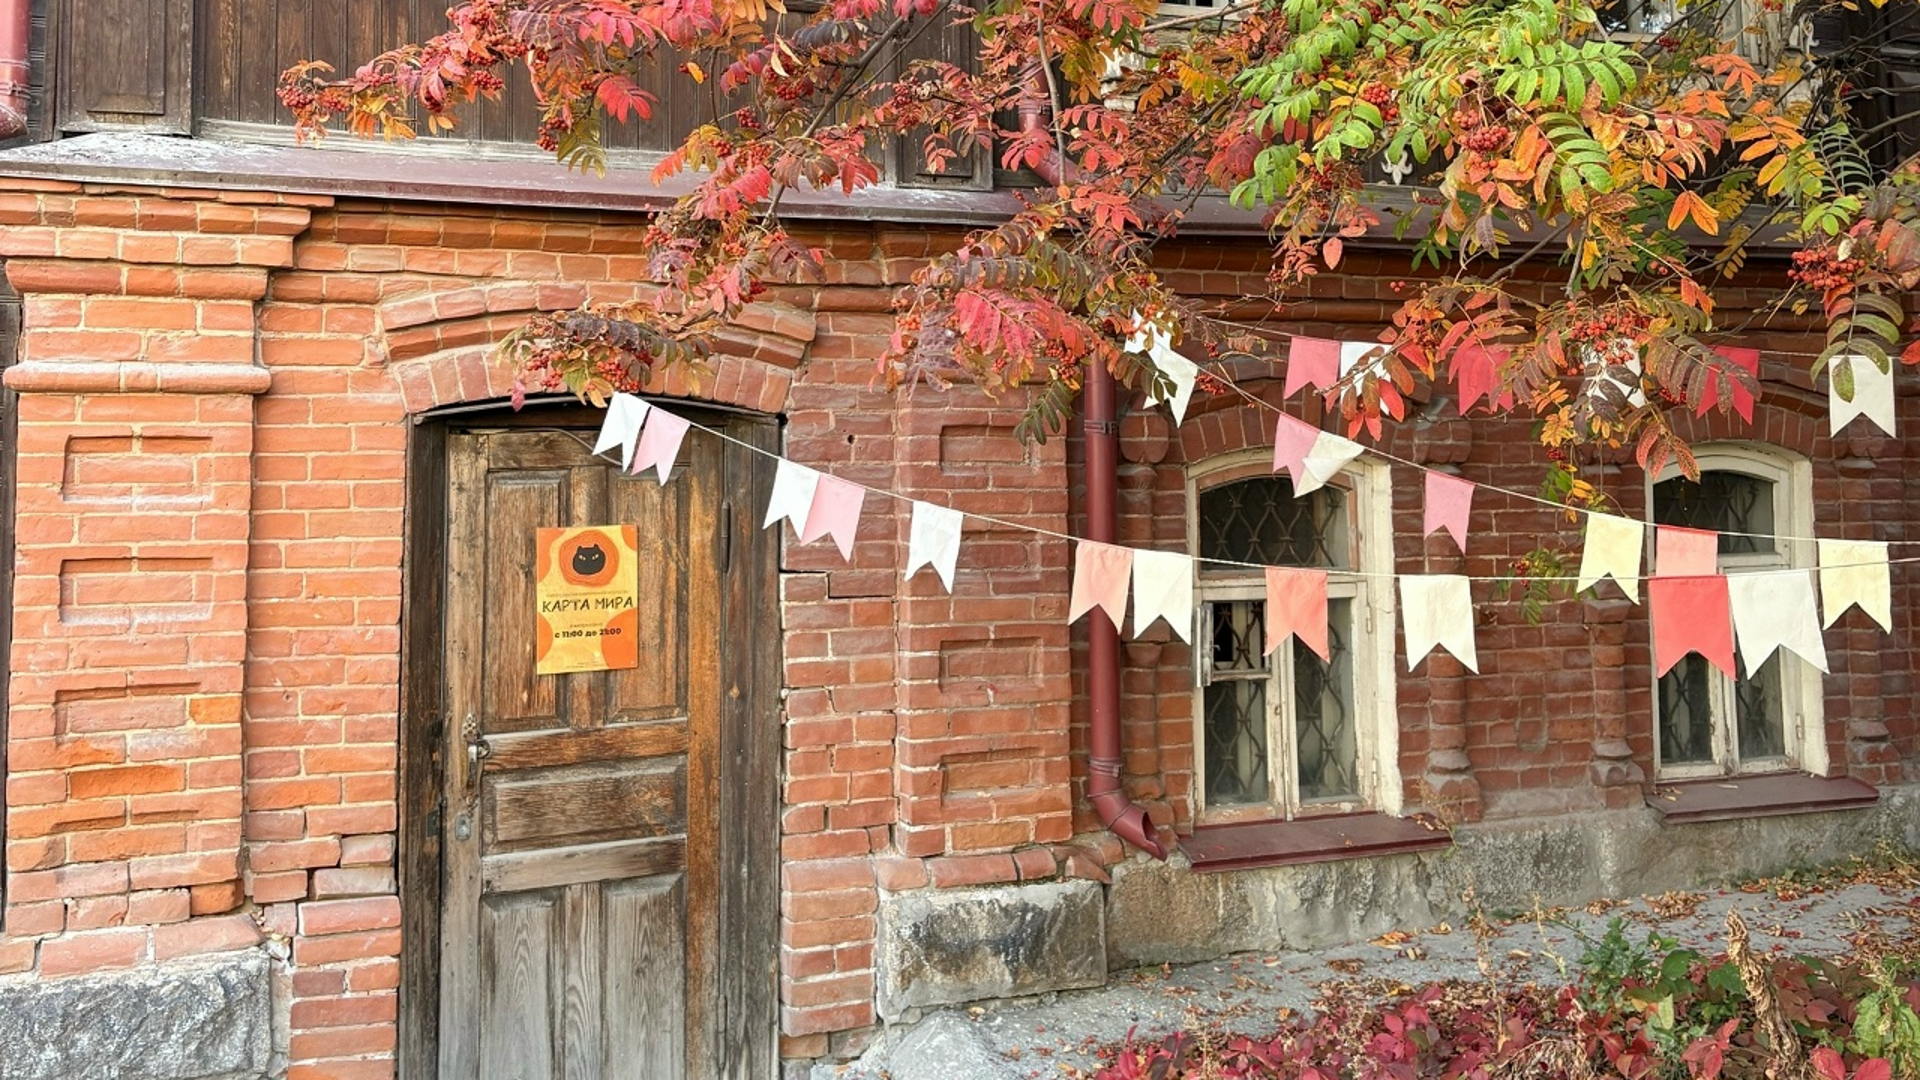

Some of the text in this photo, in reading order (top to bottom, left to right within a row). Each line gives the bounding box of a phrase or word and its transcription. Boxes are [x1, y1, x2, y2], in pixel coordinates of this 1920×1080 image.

[542, 596, 633, 613] КАРТА МИРА
[562, 629, 583, 638] 11:00
[584, 630, 597, 638] до
